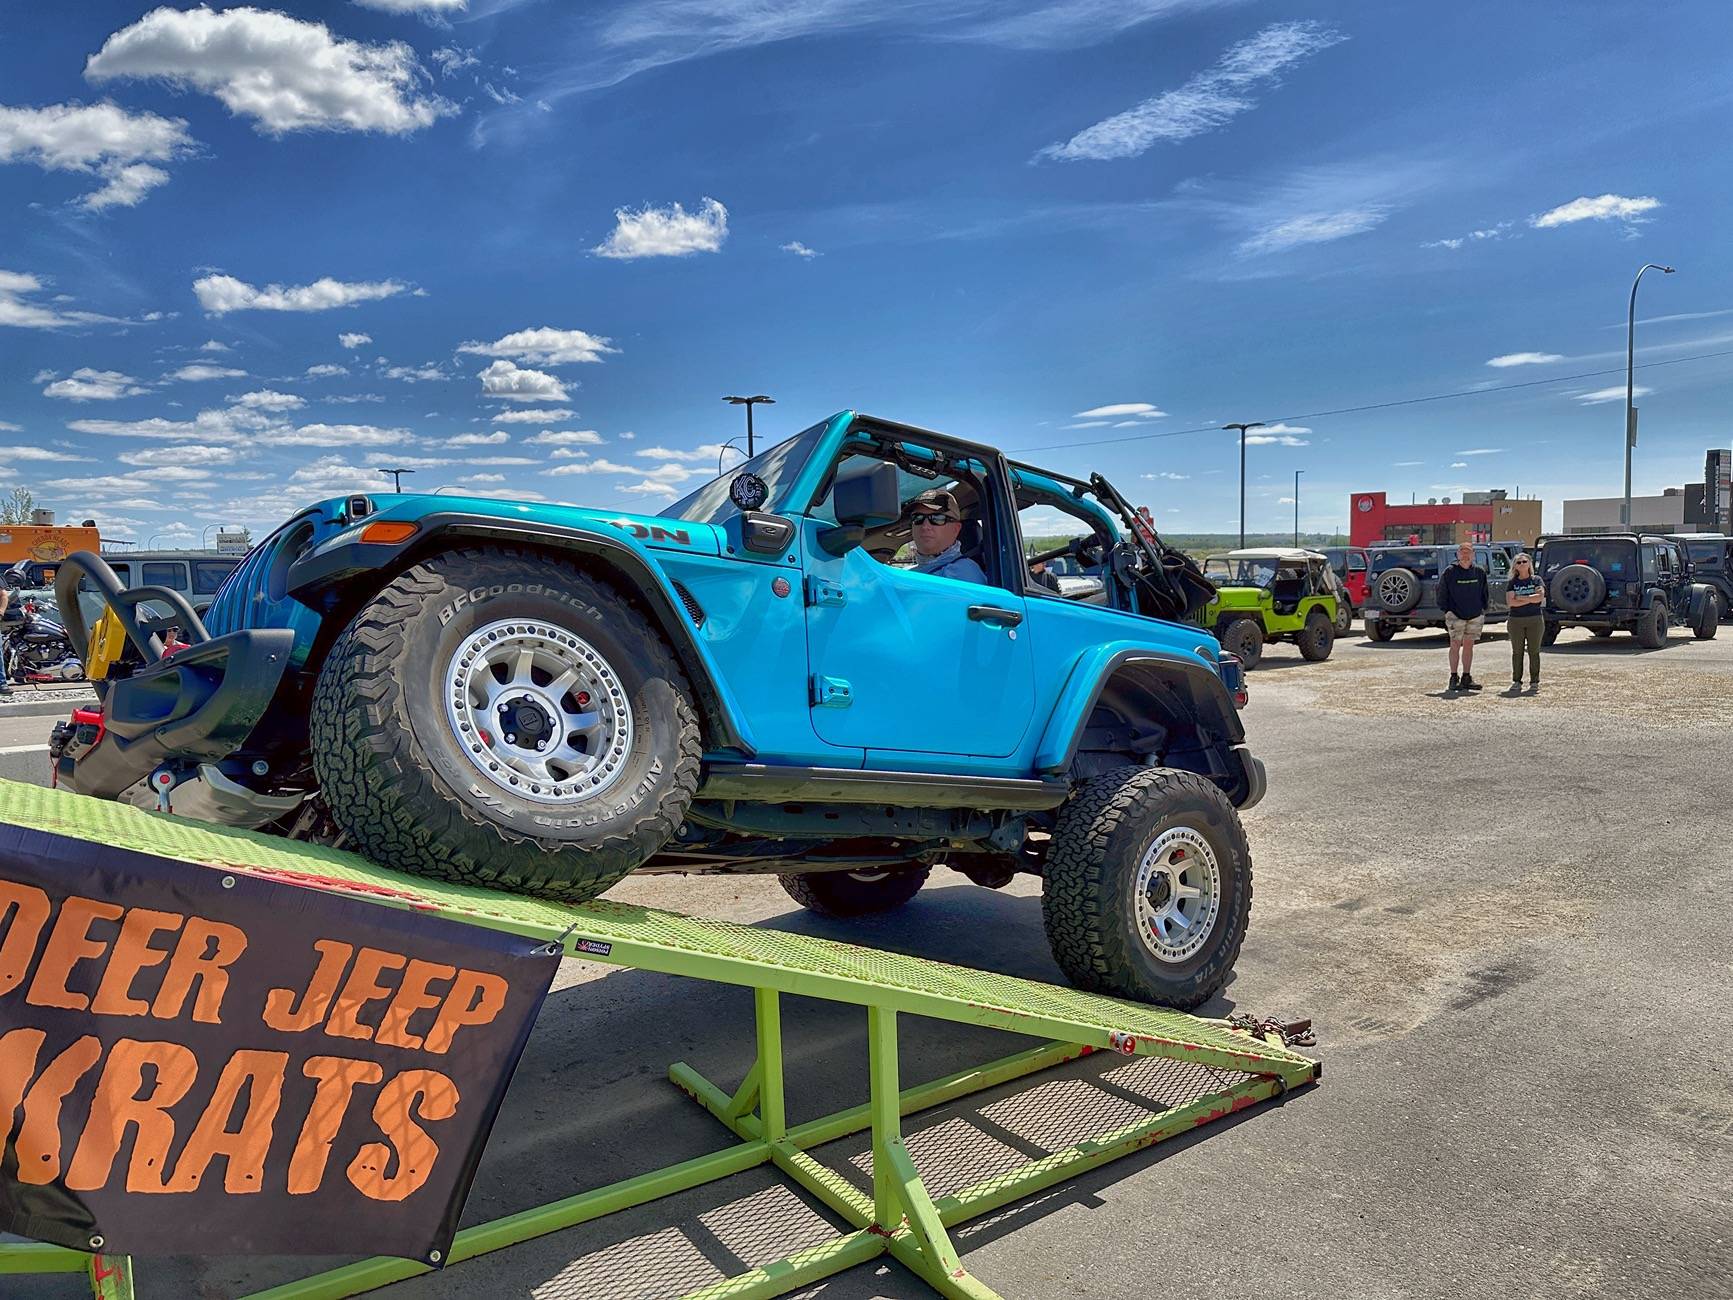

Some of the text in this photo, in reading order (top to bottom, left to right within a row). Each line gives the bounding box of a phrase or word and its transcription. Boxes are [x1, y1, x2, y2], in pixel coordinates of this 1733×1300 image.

[734, 475, 756, 500] KC
[436, 583, 604, 628] BFGoodrich
[467, 755, 664, 830] All-Terrain T/A
[0, 878, 509, 1055] DEER JEEP
[0, 1027, 461, 1203] KRATS
